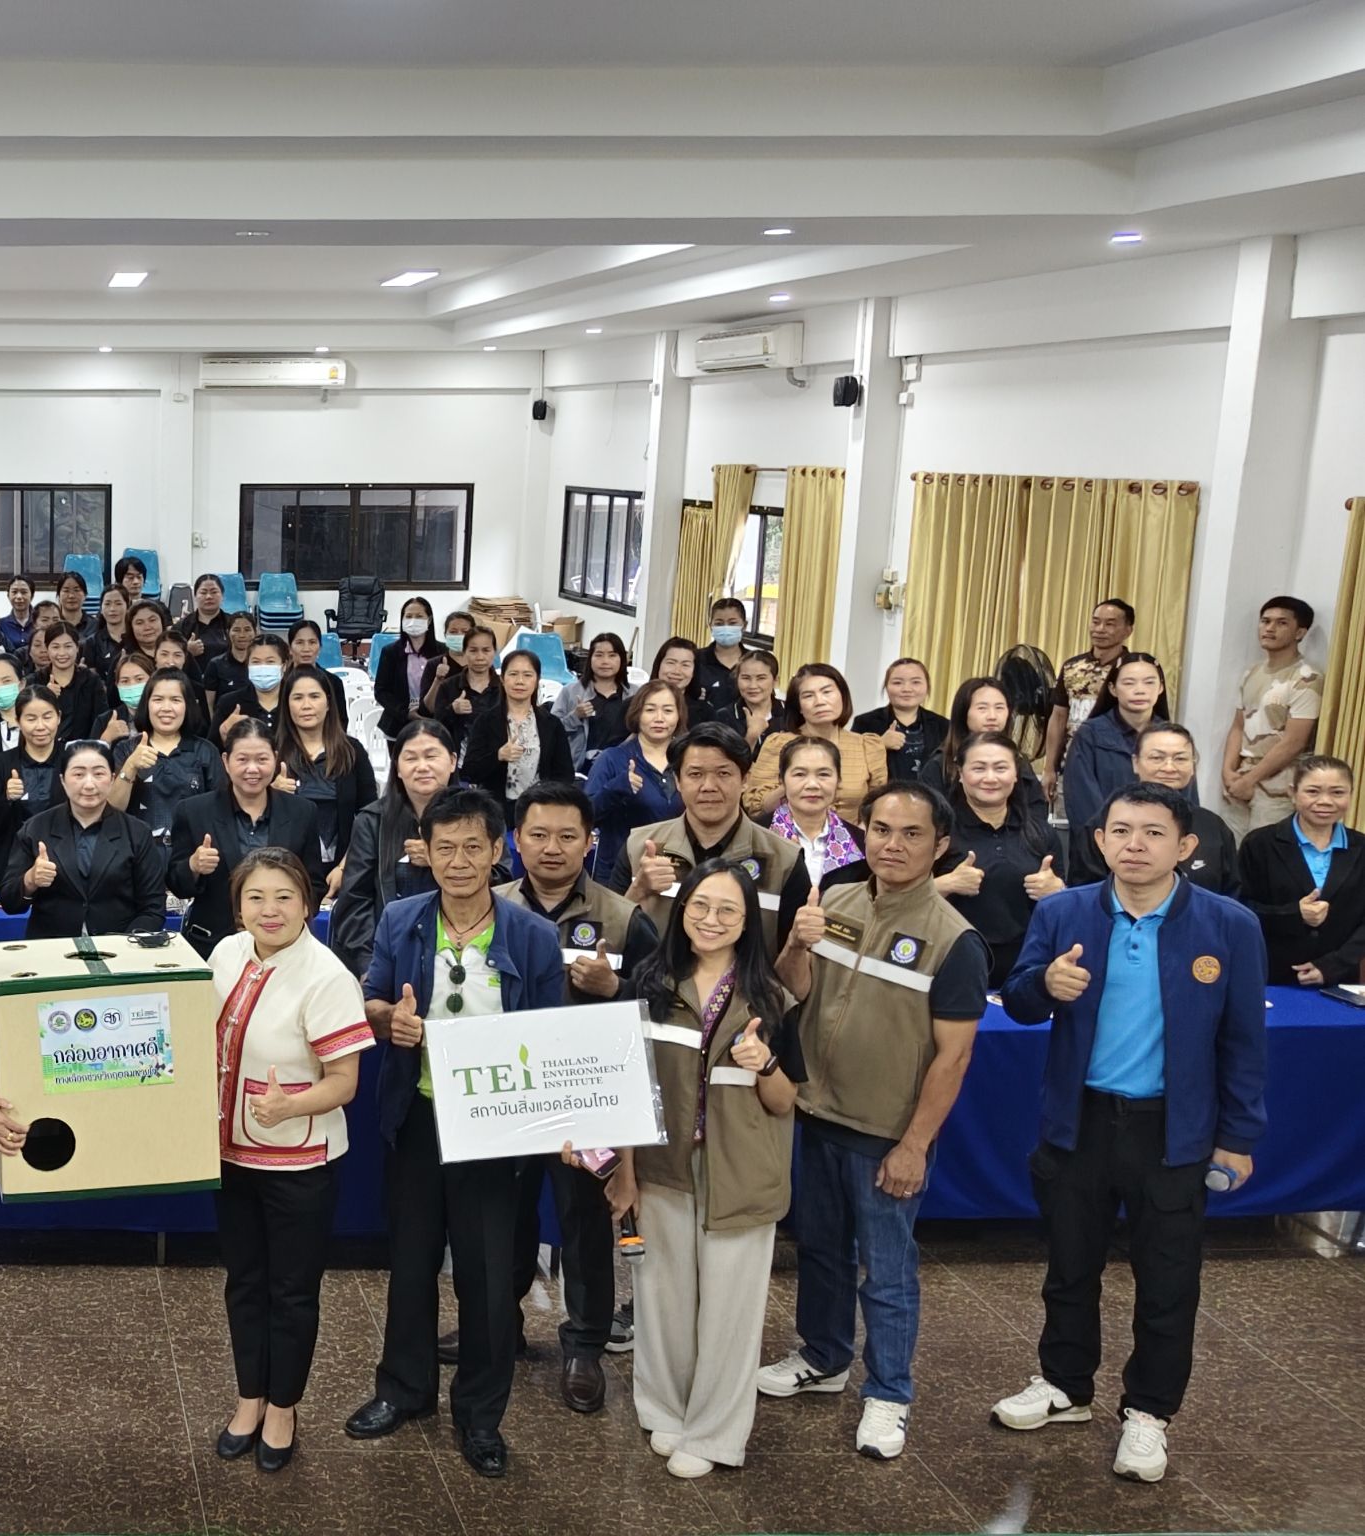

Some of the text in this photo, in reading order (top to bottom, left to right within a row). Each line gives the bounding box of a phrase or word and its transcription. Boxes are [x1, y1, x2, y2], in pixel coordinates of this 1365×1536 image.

[53, 1037, 159, 1064] กล่องอากาศดี
[541, 1056, 599, 1068] THAILAND
[542, 1064, 626, 1079] ENVIRONMENT
[543, 1076, 603, 1089] INSTITUTE
[470, 1092, 619, 1119] สถาบันสิ่งแวดล้อมไทย
